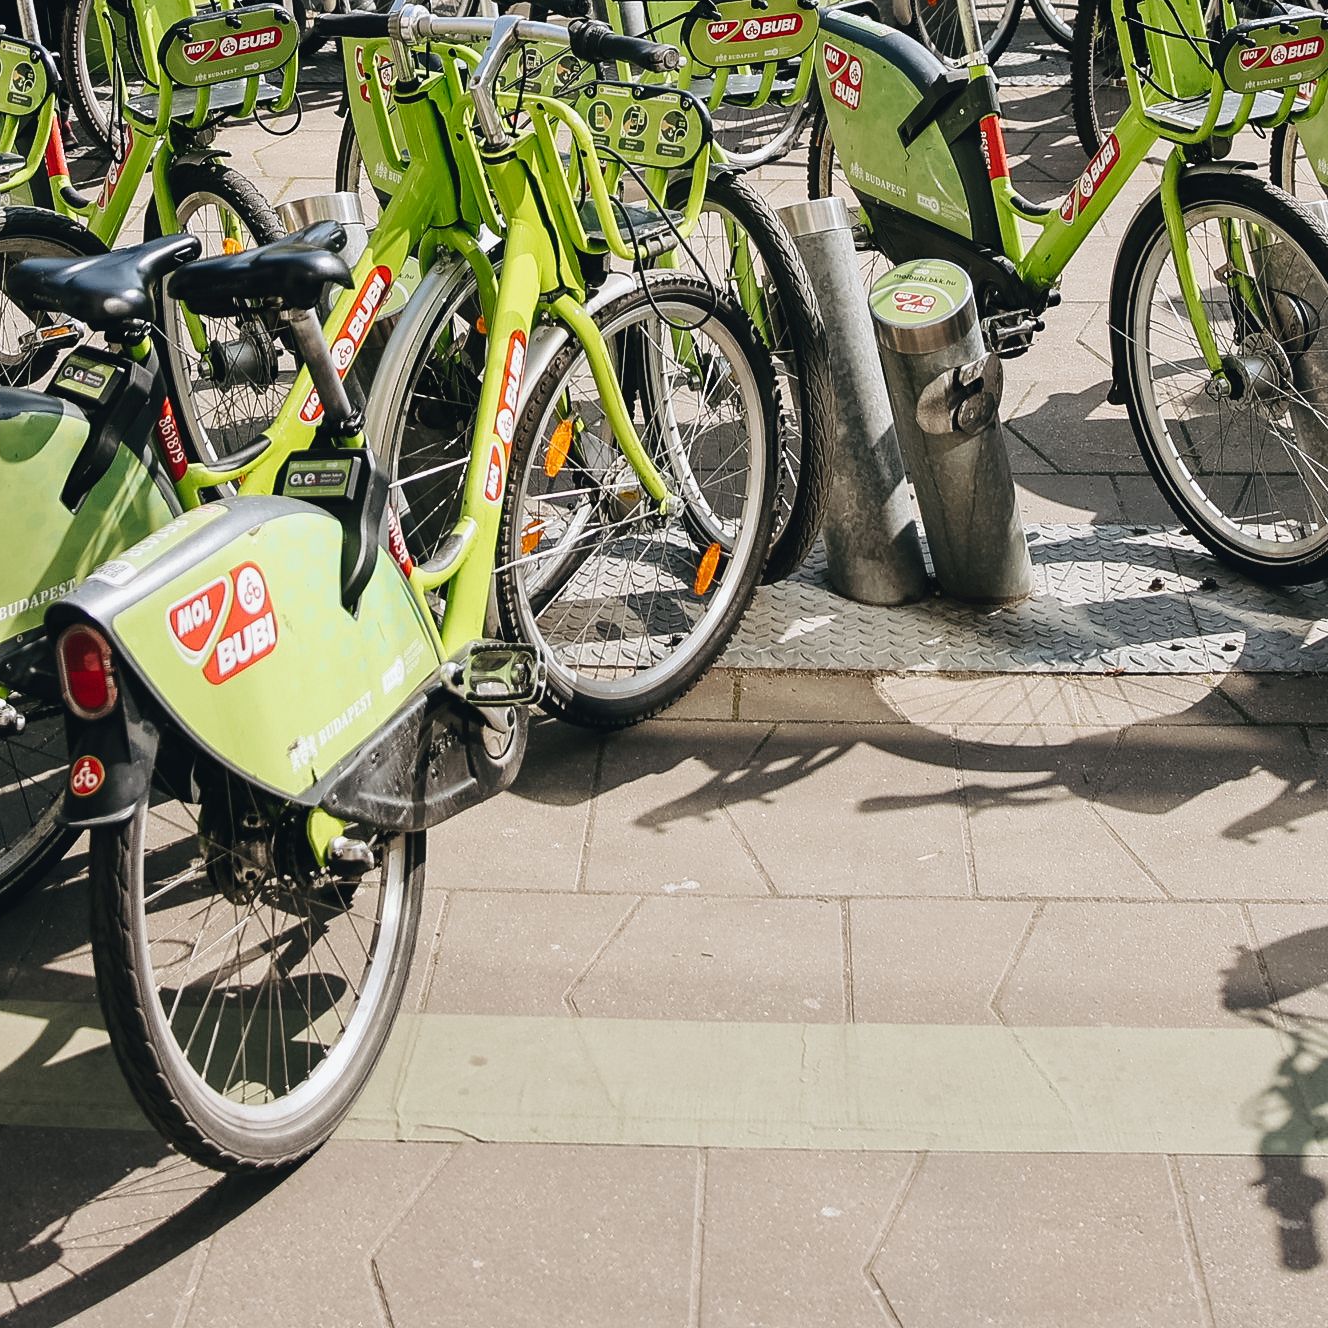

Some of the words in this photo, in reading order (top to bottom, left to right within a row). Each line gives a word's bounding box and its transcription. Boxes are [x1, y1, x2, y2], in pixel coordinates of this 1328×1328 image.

[711, 23, 729, 34] MOL
[761, 17, 797, 35] BUBI
[187, 44, 205, 55] MOL
[238, 30, 276, 50] BUBI
[1242, 50, 1258, 61] MOL
[1287, 41, 1319, 59] BUBI
[728, 52, 759, 60] BUDAPEST
[825, 47, 840, 66] MOL
[207, 68, 238, 79] BUDAPEST
[1256, 77, 1284, 86] BUDAPEST
[834, 80, 859, 108] BUBI
[1090, 138, 1116, 183] BUBI
[865, 172, 907, 198] BUDAPEST
[893, 272, 957, 286] molbubi.bkk.hu
[901, 303, 931, 313] BUBI
[303, 391, 321, 420] MO
[347, 273, 386, 342] BUBI
[504, 338, 525, 414] BUBI
[158, 415, 184, 464] 861879
[177, 594, 213, 639] MOL
[217, 611, 276, 677] BUBI
[318, 689, 372, 748] BUDAPEST
